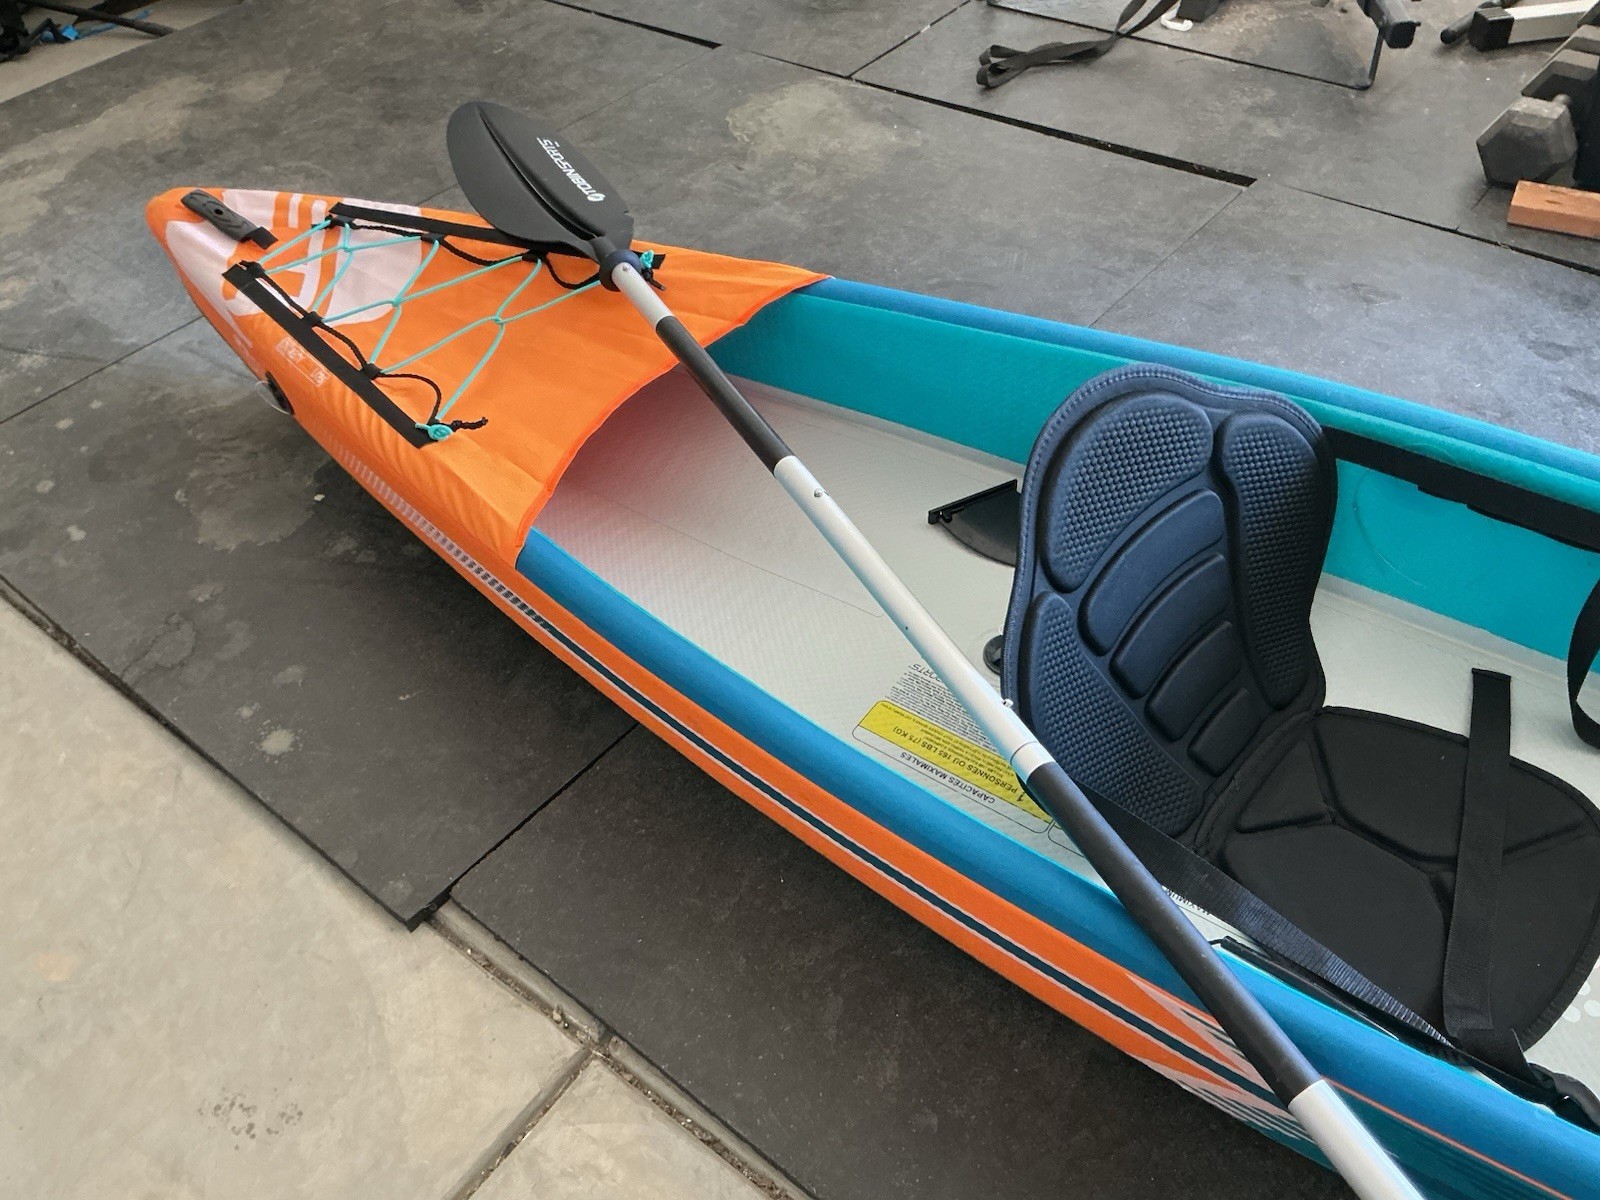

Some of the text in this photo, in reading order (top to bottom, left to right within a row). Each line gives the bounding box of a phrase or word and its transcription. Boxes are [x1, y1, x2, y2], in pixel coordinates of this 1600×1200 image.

[536, 136, 597, 196] TOBINSPORTS
[893, 725, 909, 740] KG)
[908, 733, 921, 747] (75
[920, 741, 938, 753] LBS
[937, 749, 951, 761] 165
[952, 757, 967, 769] OU
[900, 751, 996, 804] CAPACITÉS MAXIMALES
[966, 764, 1018, 793] PERSONNES
